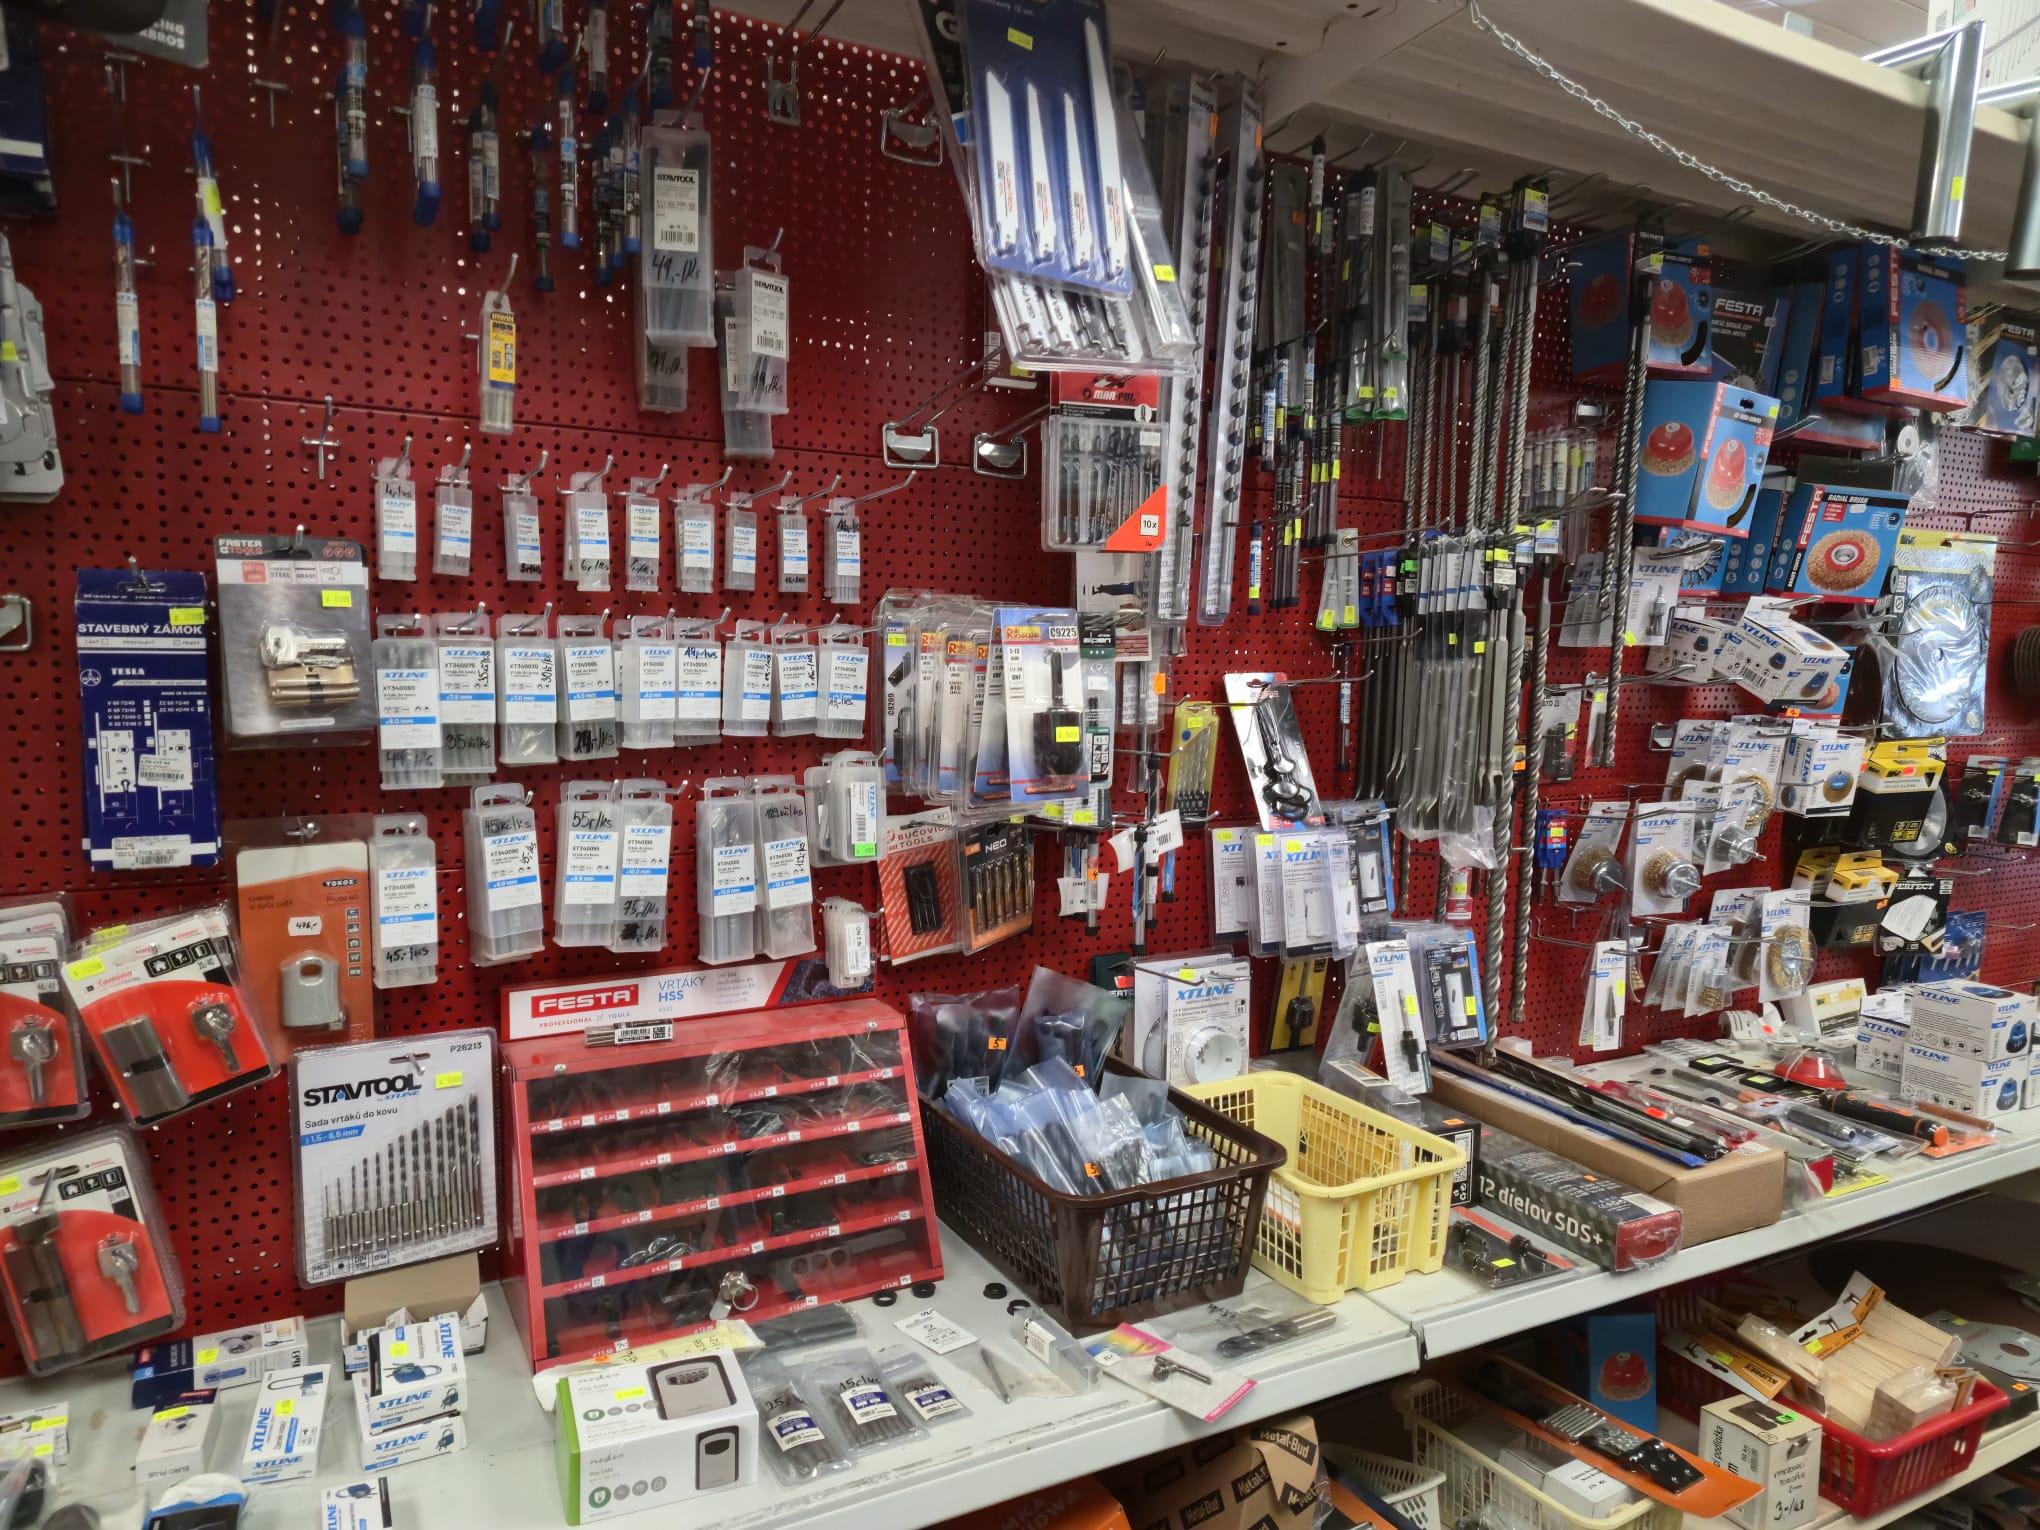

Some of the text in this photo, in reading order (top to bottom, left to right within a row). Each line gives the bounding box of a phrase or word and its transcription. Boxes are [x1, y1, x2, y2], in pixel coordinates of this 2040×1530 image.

[657, 173, 696, 184] STAVTOOL
[754, 280, 785, 294] STAVTOOL
[1715, 298, 1763, 316] FESTA
[1143, 520, 1151, 528] 10
[1800, 491, 1822, 544] FESTA
[1638, 565, 1680, 574] XTLINE
[78, 623, 202, 634] STAVEBNÝ ZÁMOK
[1050, 628, 1076, 638] C9225
[1672, 623, 1698, 633] TLINE
[1741, 622, 1781, 648] XTLINE
[1802, 657, 1831, 665] XTLINE
[111, 668, 145, 676] TESLA
[1641, 818, 1679, 826] XTLINE
[900, 836, 933, 849] TOOLS
[985, 839, 1007, 853] NEO
[1765, 908, 1791, 917] XTLINE
[1373, 953, 1407, 963] XTLINE
[658, 975, 706, 991] VRTÁKY
[659, 991, 684, 1002] HSS
[1176, 983, 1236, 1000] XTLINE
[1920, 990, 1960, 1005] XTLINE
[540, 990, 630, 1012] FESTA
[1998, 1002, 2021, 1012] XTLINE
[540, 1017, 592, 1028] PROFESSIONAL
[1864, 1022, 1904, 1037] XTLINE
[1910, 1046, 1950, 1062] XTLINE
[1985, 1060, 2012, 1070] XTLINE
[304, 1073, 422, 1107] STAVTOOL
[305, 1107, 398, 1129] Sada vrtáků do kovu
[1480, 1175, 1495, 1198] 12
[1498, 1187, 1551, 1225] dielov
[1554, 1212, 1604, 1245] SDS+
[440, 1322, 455, 1358] XTLINE
[377, 1389, 432, 1410] XTLINE
[251, 1407, 272, 1451] XTLINE
[374, 1431, 429, 1451] XTLINE
[1259, 1431, 1310, 1458] Metal-Bud
[253, 1455, 304, 1470] XTLINE
[326, 1503, 337, 1530] TLINE
